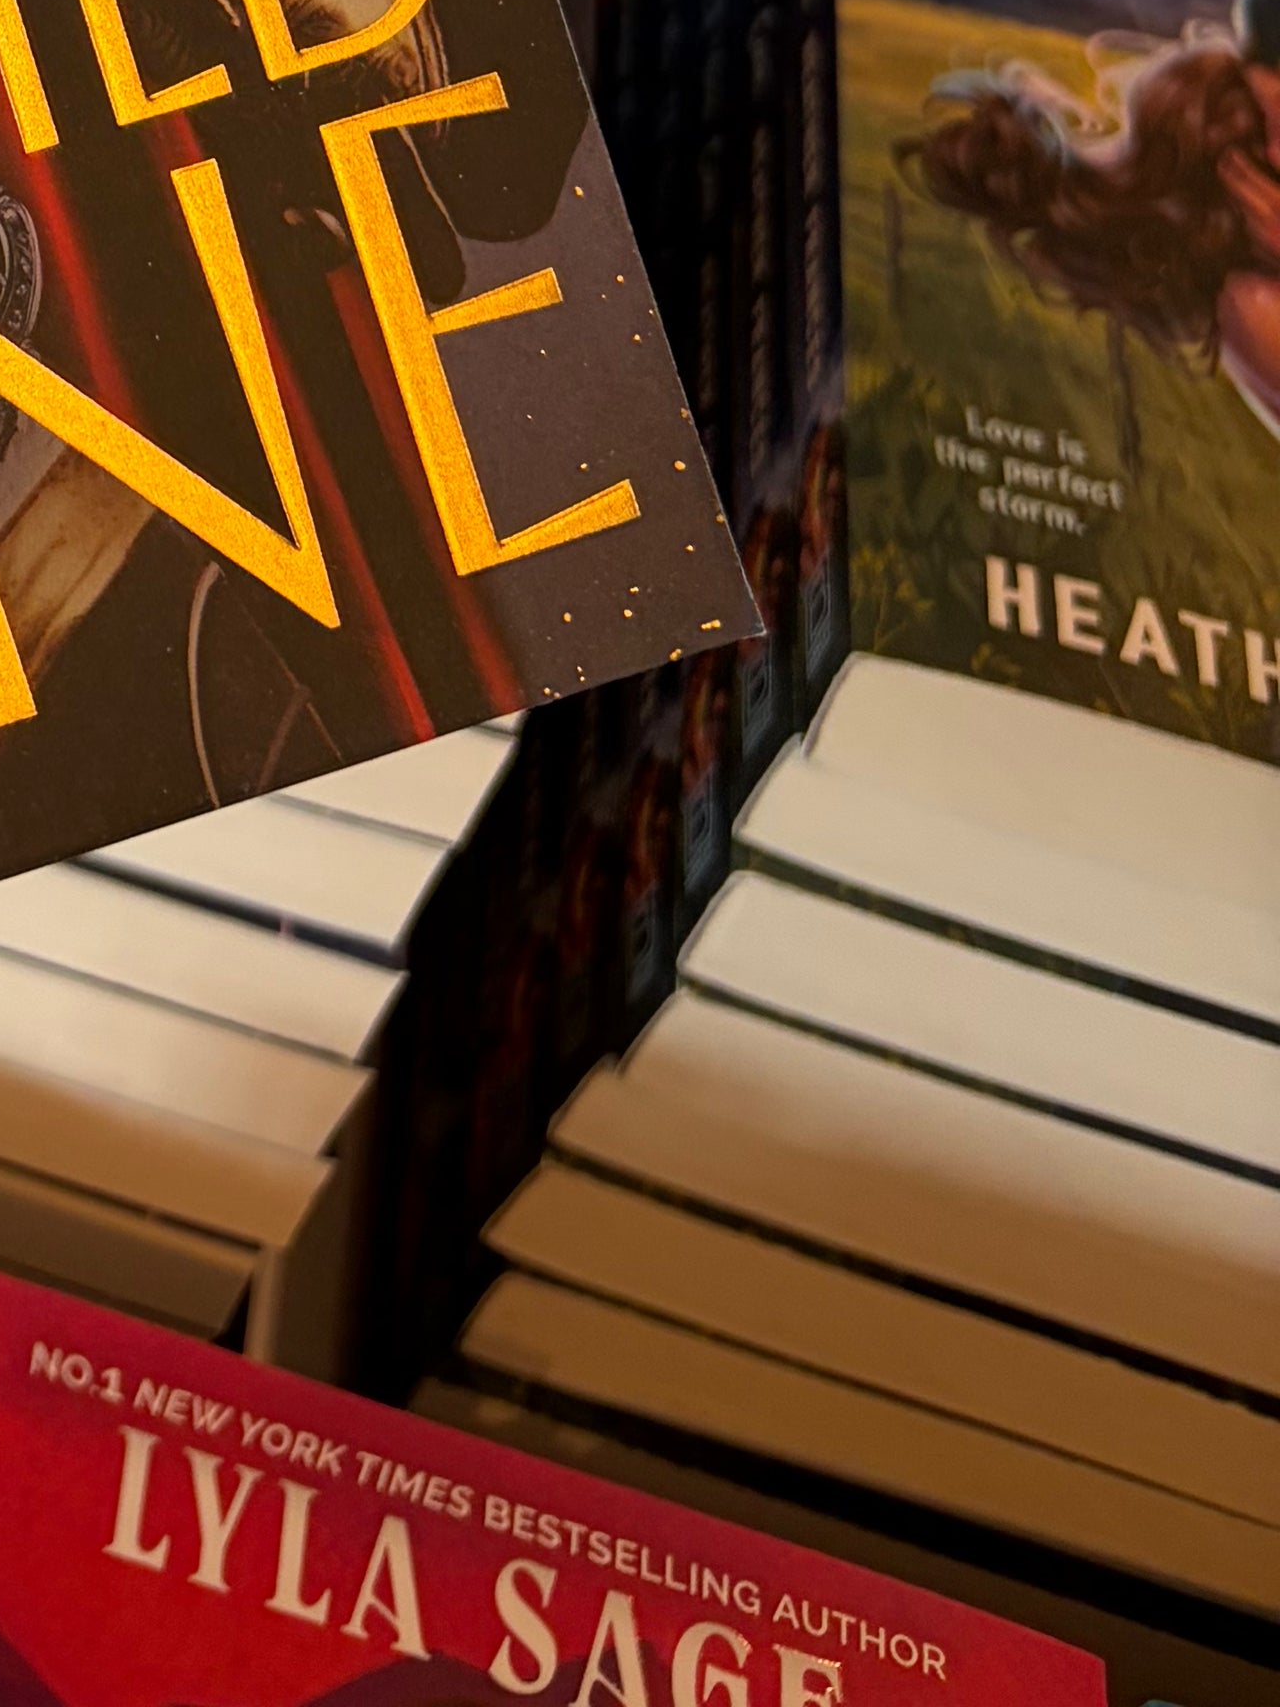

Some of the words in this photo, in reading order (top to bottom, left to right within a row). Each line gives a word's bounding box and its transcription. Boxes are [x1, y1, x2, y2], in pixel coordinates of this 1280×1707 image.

[934, 434, 993, 476] the
[1002, 456, 1126, 513] perfect
[964, 404, 1046, 455] Love
[1057, 428, 1090, 467] is
[977, 484, 1089, 537] storm.
[101, 1422, 434, 1661] LYLA
[131, 1379, 237, 1437] NEW
[238, 1410, 344, 1480] YORK
[353, 1448, 473, 1521] TIMES
[481, 1492, 763, 1618] BESTSELLING
[769, 1592, 950, 1682] AUTHOR
